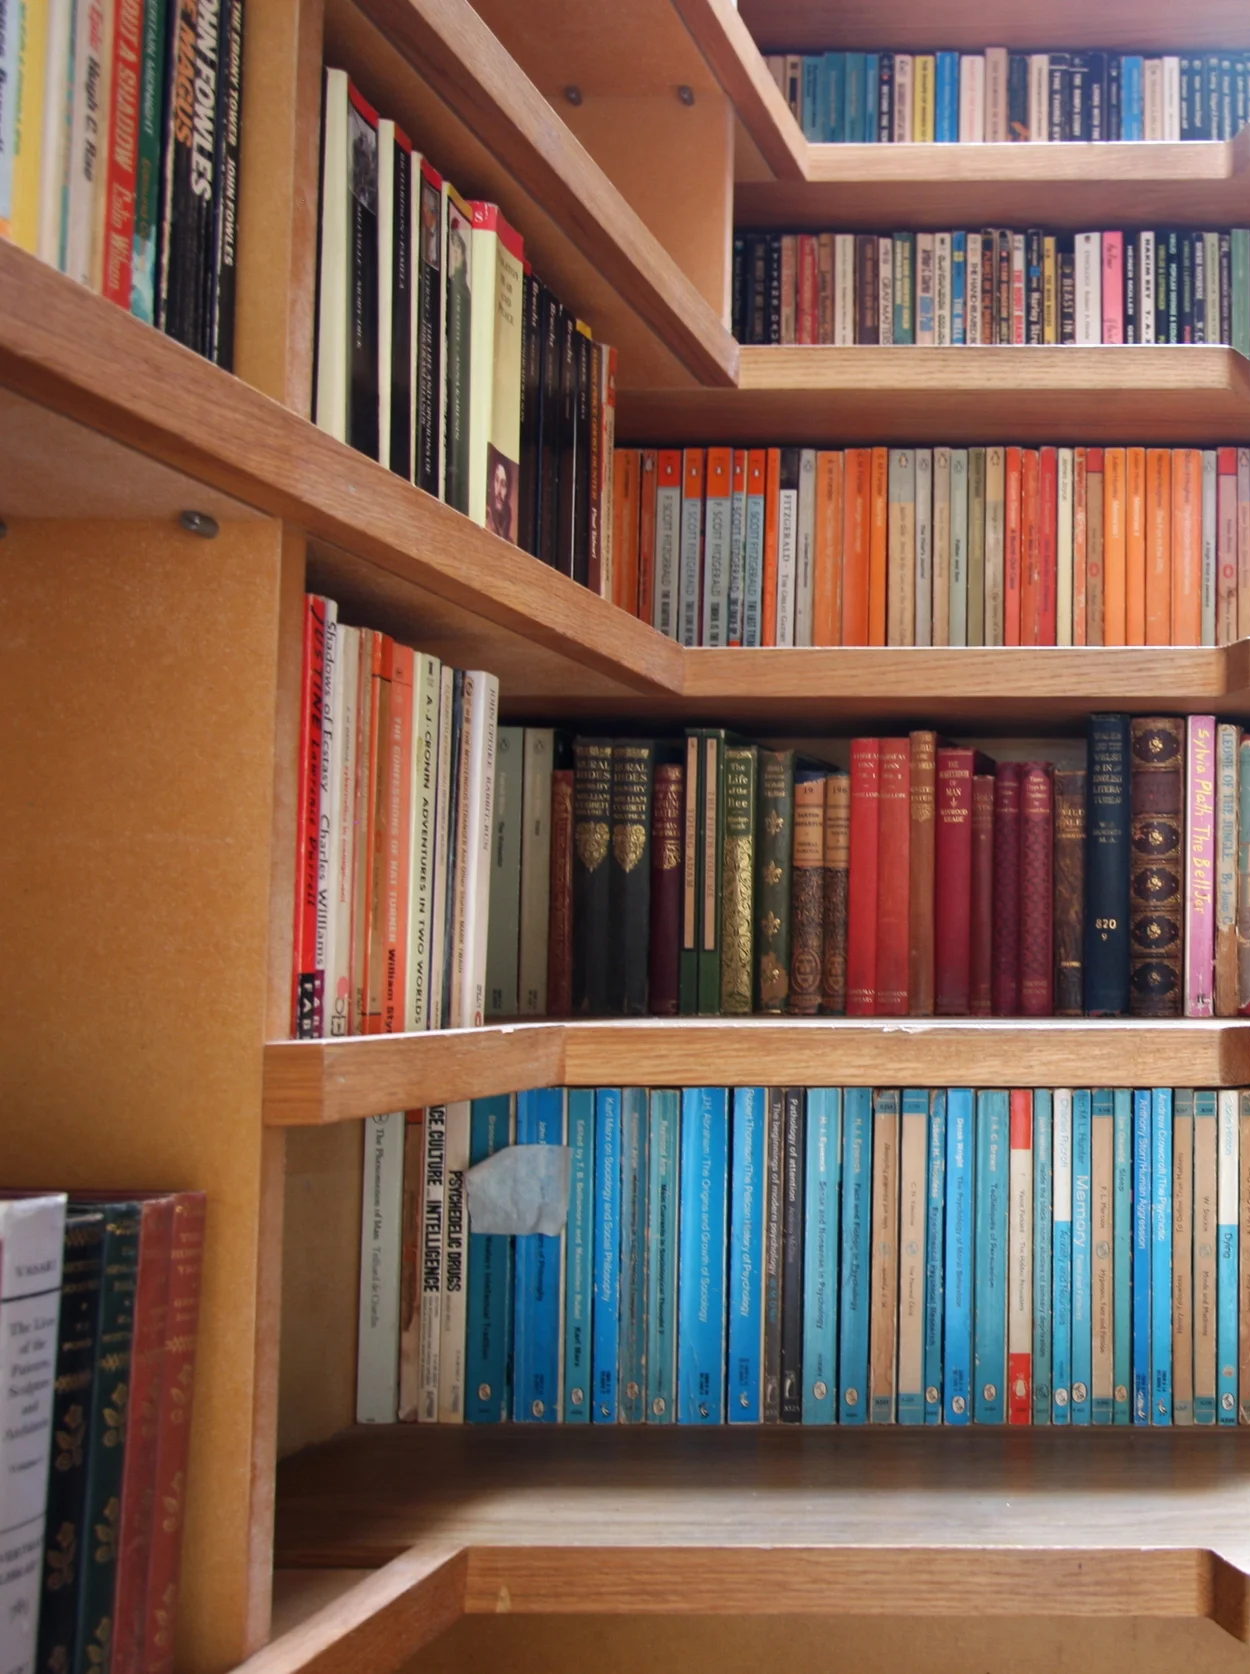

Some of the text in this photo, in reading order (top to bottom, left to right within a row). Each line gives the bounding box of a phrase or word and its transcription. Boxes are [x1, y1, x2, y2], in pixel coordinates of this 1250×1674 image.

[144, 59, 156, 137] MIDNIGHT
[175, 26, 197, 147] MAGUS
[228, 32, 240, 86] EBONY
[83, 55, 101, 182] Hugh C. Rae
[189, 66, 217, 203] FOWLES
[227, 89, 239, 146] TOWER
[108, 64, 138, 290] SHADOW Colin Wilson
[226, 157, 236, 197] JOHN
[223, 198, 235, 266] FOWLES
[1063, 278, 1074, 313] BEAST
[565, 320, 573, 364] Brecht
[711, 511, 722, 597] SCOTT FITZGERALD
[749, 511, 758, 596] SCOTT FITZGERALD
[782, 495, 793, 562] FITZGERALD
[311, 606, 325, 728] JUSTINE
[486, 689, 496, 769] JOHN UPDIKE
[317, 621, 335, 966] Shadows Ecstasy Charles Williams
[1191, 728, 1213, 915] Sylvia Plath The Bell Jar
[1221, 775, 1233, 789] OF
[1221, 794, 1233, 815] THE
[415, 731, 432, 1025] CRONIN ADVENTURES TWO WORLDS
[1095, 918, 1117, 930] 820
[387, 948, 396, 1001] William
[602, 1157, 612, 1199] Sociology
[787, 1099, 797, 1202] Pathology attention
[1136, 1099, 1148, 1249] Anthony Aggression
[424, 1130, 444, 1293] CULTURE INTELLIGENCE
[446, 1171, 462, 1292] PSYCHEDELIC DRUGS
[768, 1122, 781, 1276] beginnings modern psychology
[1073, 1174, 1088, 1248] Memory
[601, 1252, 612, 1303] Philosophy
[1223, 1232, 1234, 1259] Dying
